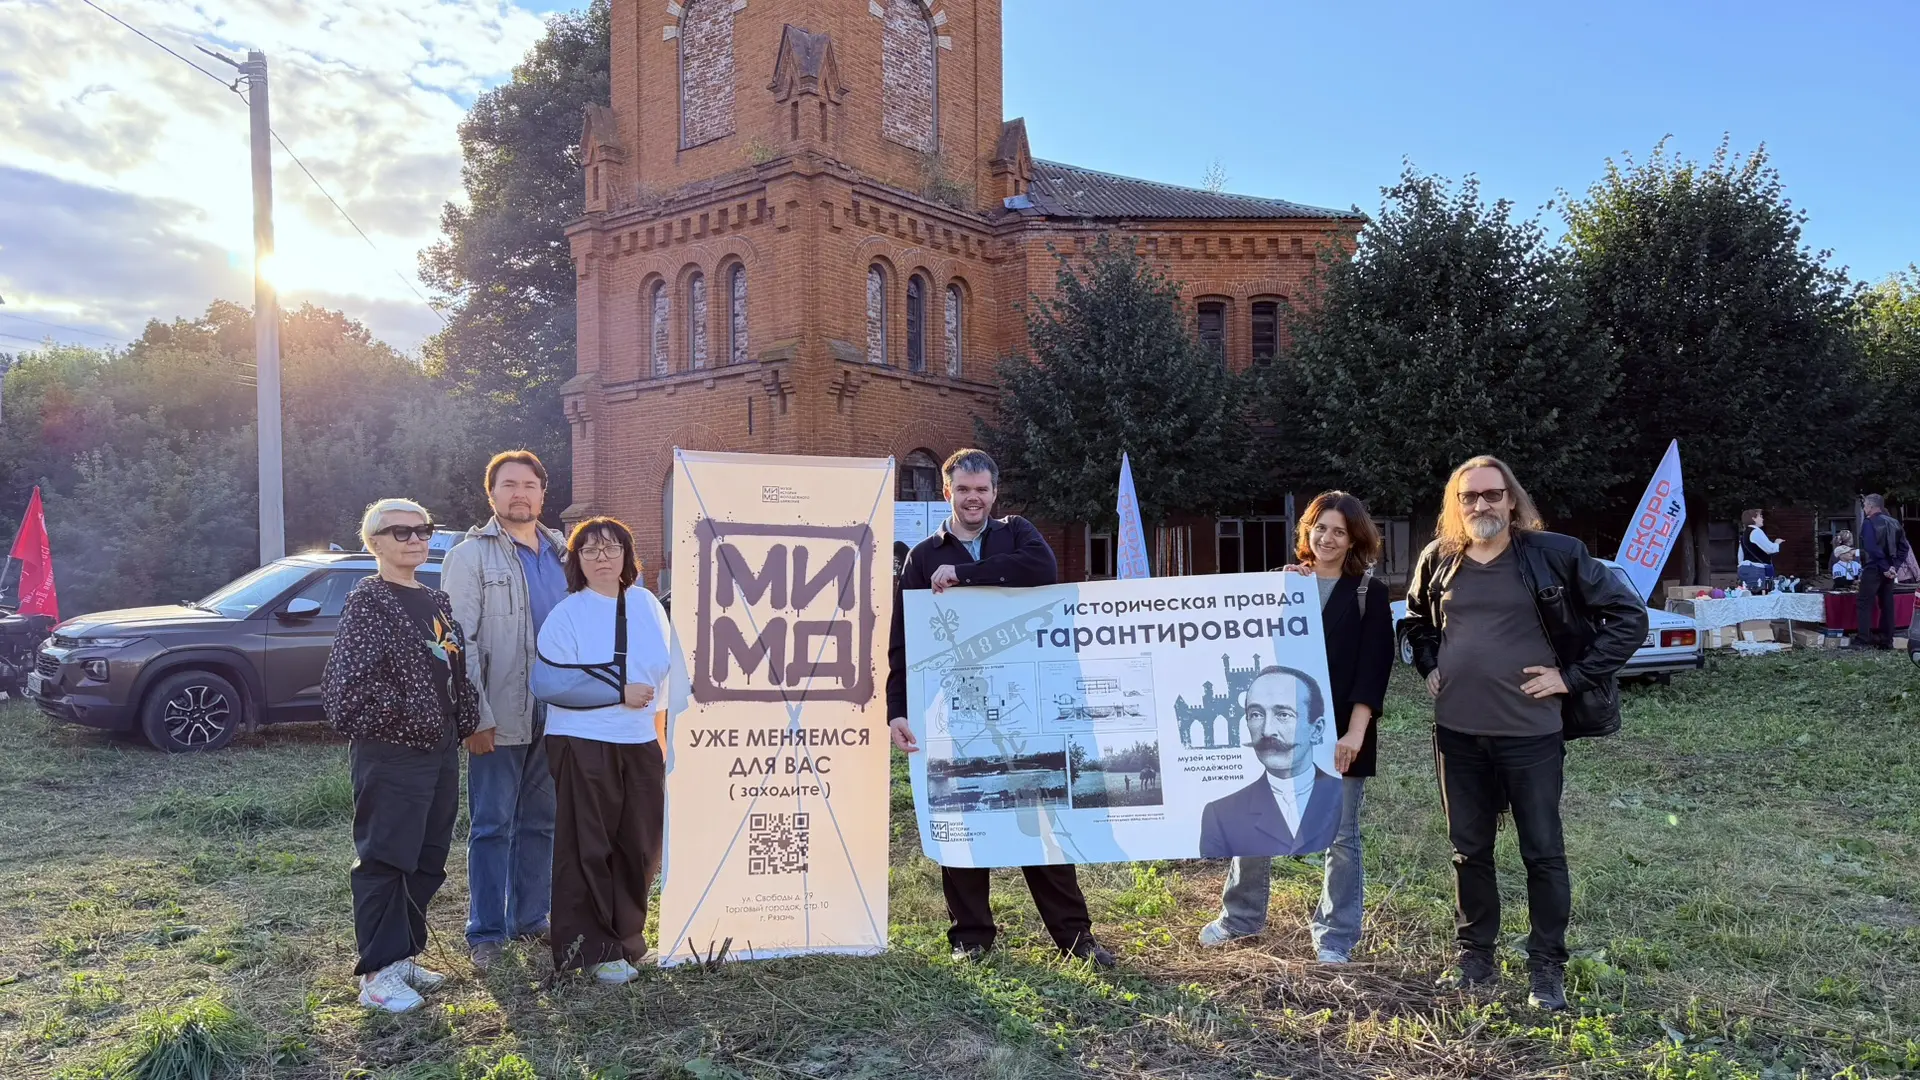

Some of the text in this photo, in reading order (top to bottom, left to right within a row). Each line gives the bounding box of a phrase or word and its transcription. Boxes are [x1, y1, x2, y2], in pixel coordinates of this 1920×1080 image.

[1625, 479, 1671, 562] СКОРО
[714, 542, 857, 612] МИ
[1063, 591, 1305, 617] историческая правда
[1036, 614, 1309, 653] гарантирована
[712, 615, 857, 689] МД
[689, 727, 870, 748] УЖЕ МЕНЯЕМСЯ
[1177, 753, 1242, 763] музей истории
[728, 755, 831, 778] ДЛЯ ВАС
[1183, 763, 1243, 772] молодёжного
[1201, 774, 1244, 782] движения
[931, 823, 947, 831] МИ
[755, 893, 793, 902] Свободы
[725, 904, 764, 914] Торговый
[767, 913, 795, 921] Рязань
